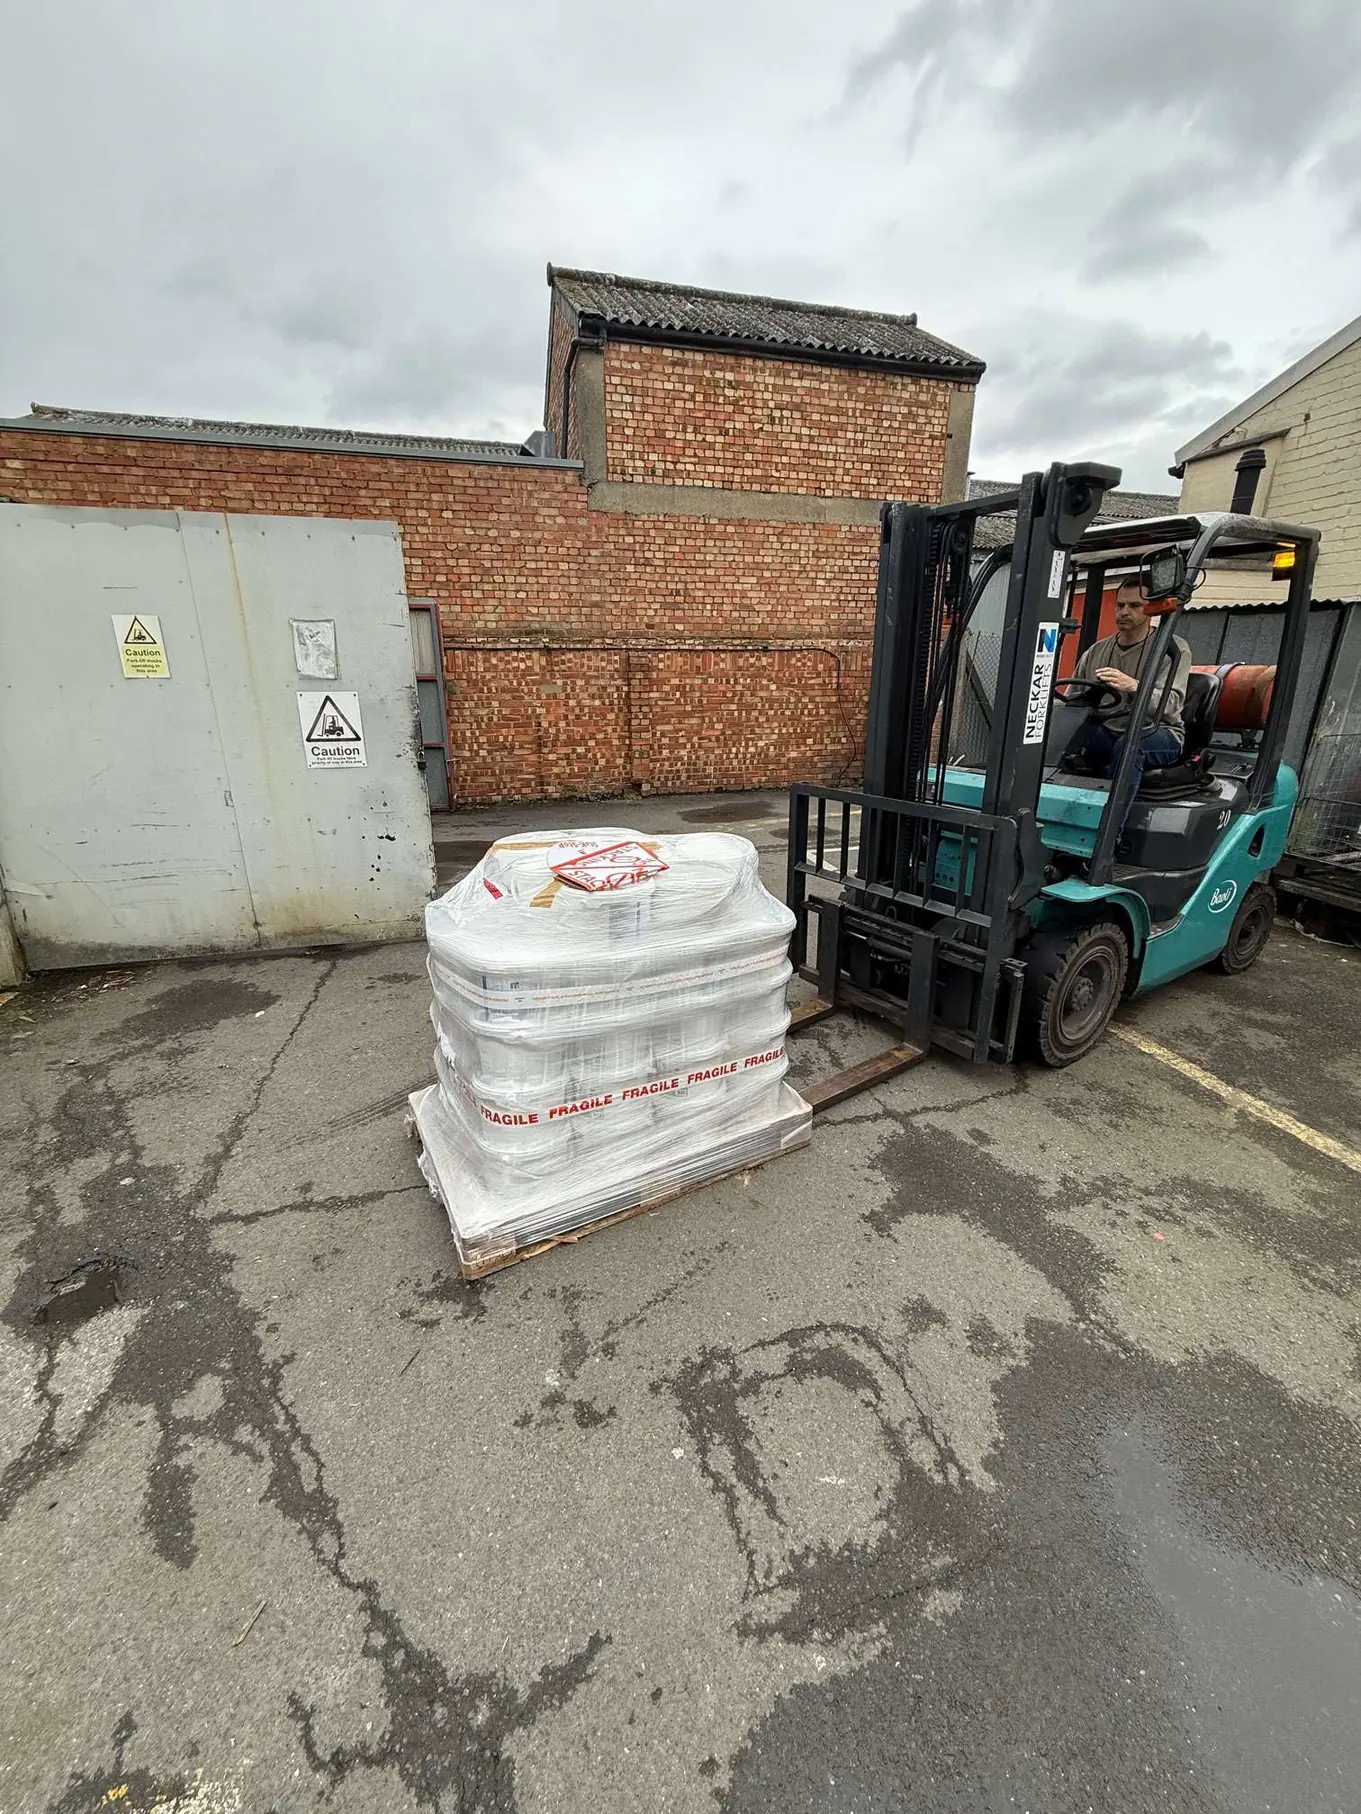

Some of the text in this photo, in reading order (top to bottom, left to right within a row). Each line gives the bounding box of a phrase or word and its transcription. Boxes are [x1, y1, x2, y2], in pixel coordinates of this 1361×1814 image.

[125, 648, 160, 656] Caution
[1025, 664, 1045, 739] NECKAR
[1035, 663, 1052, 738] FORKLIFTS
[311, 745, 360, 757] Caution
[1216, 809, 1232, 830] 20
[480, 1105, 539, 1126] FRAGILE
[548, 1094, 613, 1119] FRAGILE
[621, 1078, 679, 1101] FRAGILE
[687, 1062, 738, 1085] FRAGILE
